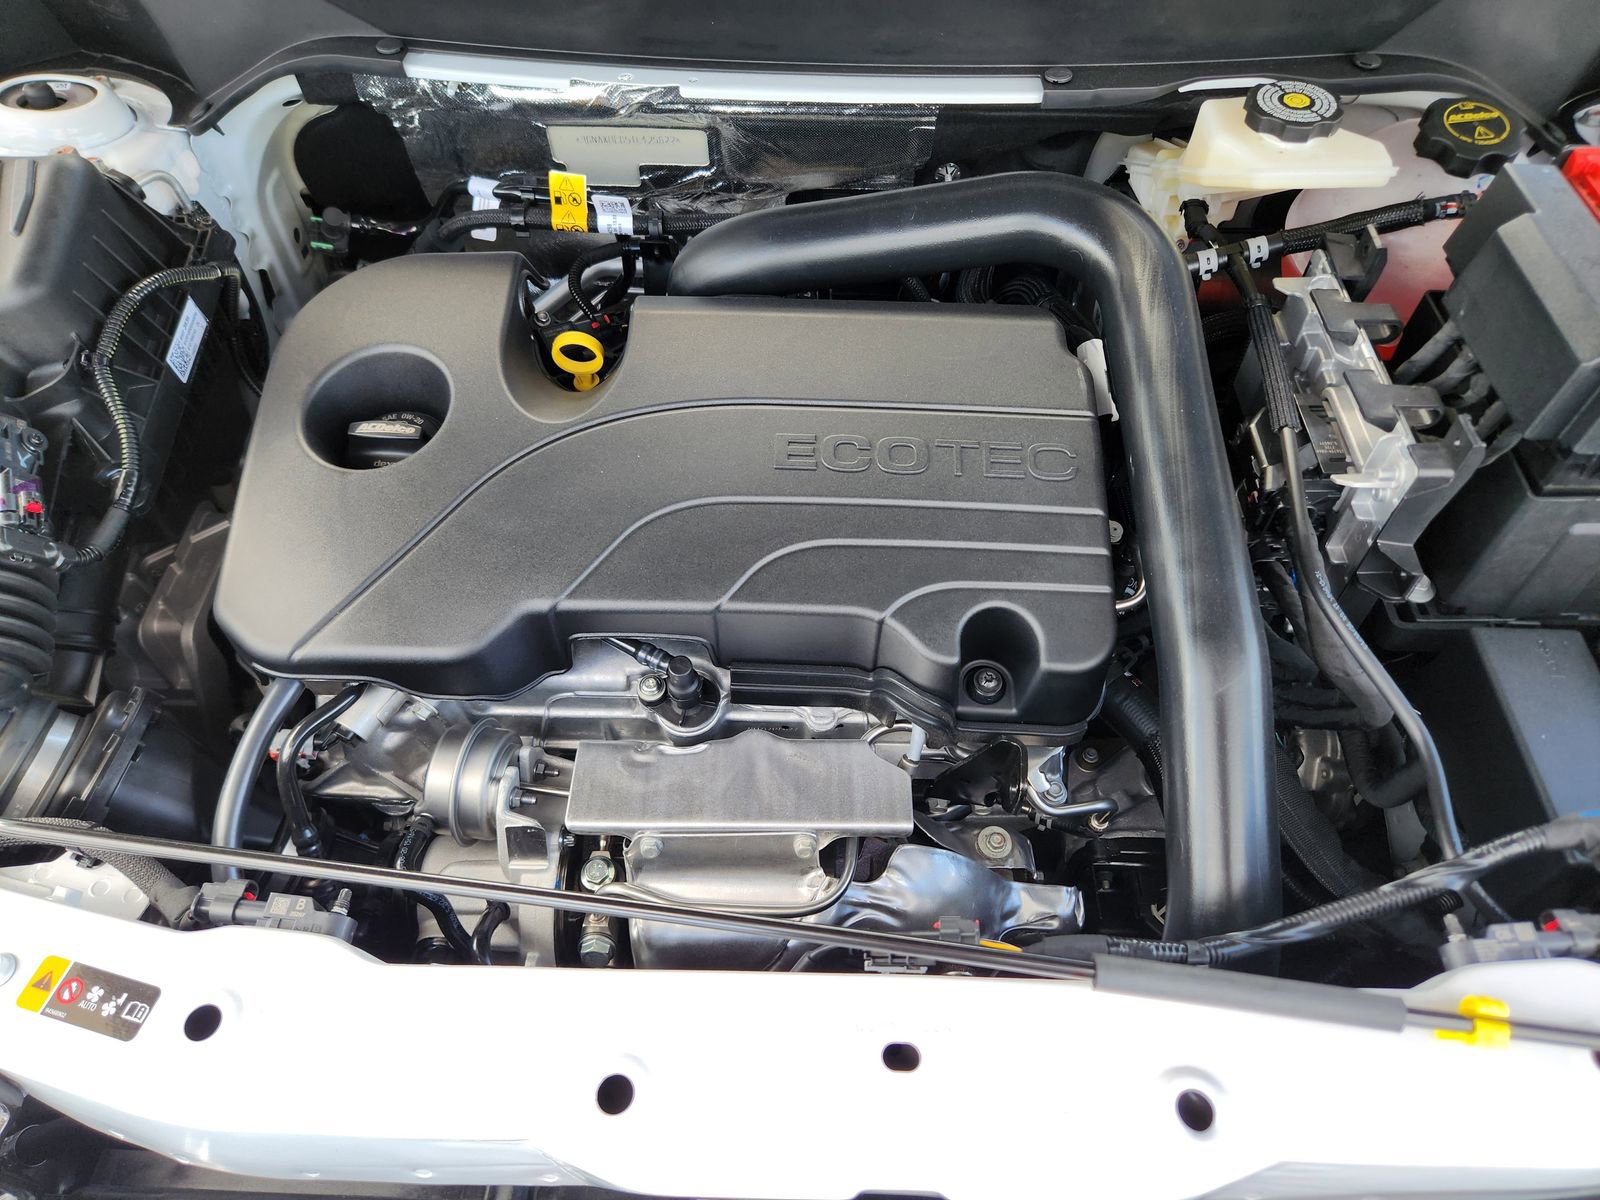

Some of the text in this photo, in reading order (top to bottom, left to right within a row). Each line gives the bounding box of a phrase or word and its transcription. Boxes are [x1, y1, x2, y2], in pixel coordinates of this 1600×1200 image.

[355, 423, 416, 434] ACDelco
[773, 432, 1079, 482] ECOTEC
[296, 897, 306, 911] B
[78, 1000, 98, 1012] AUTO
